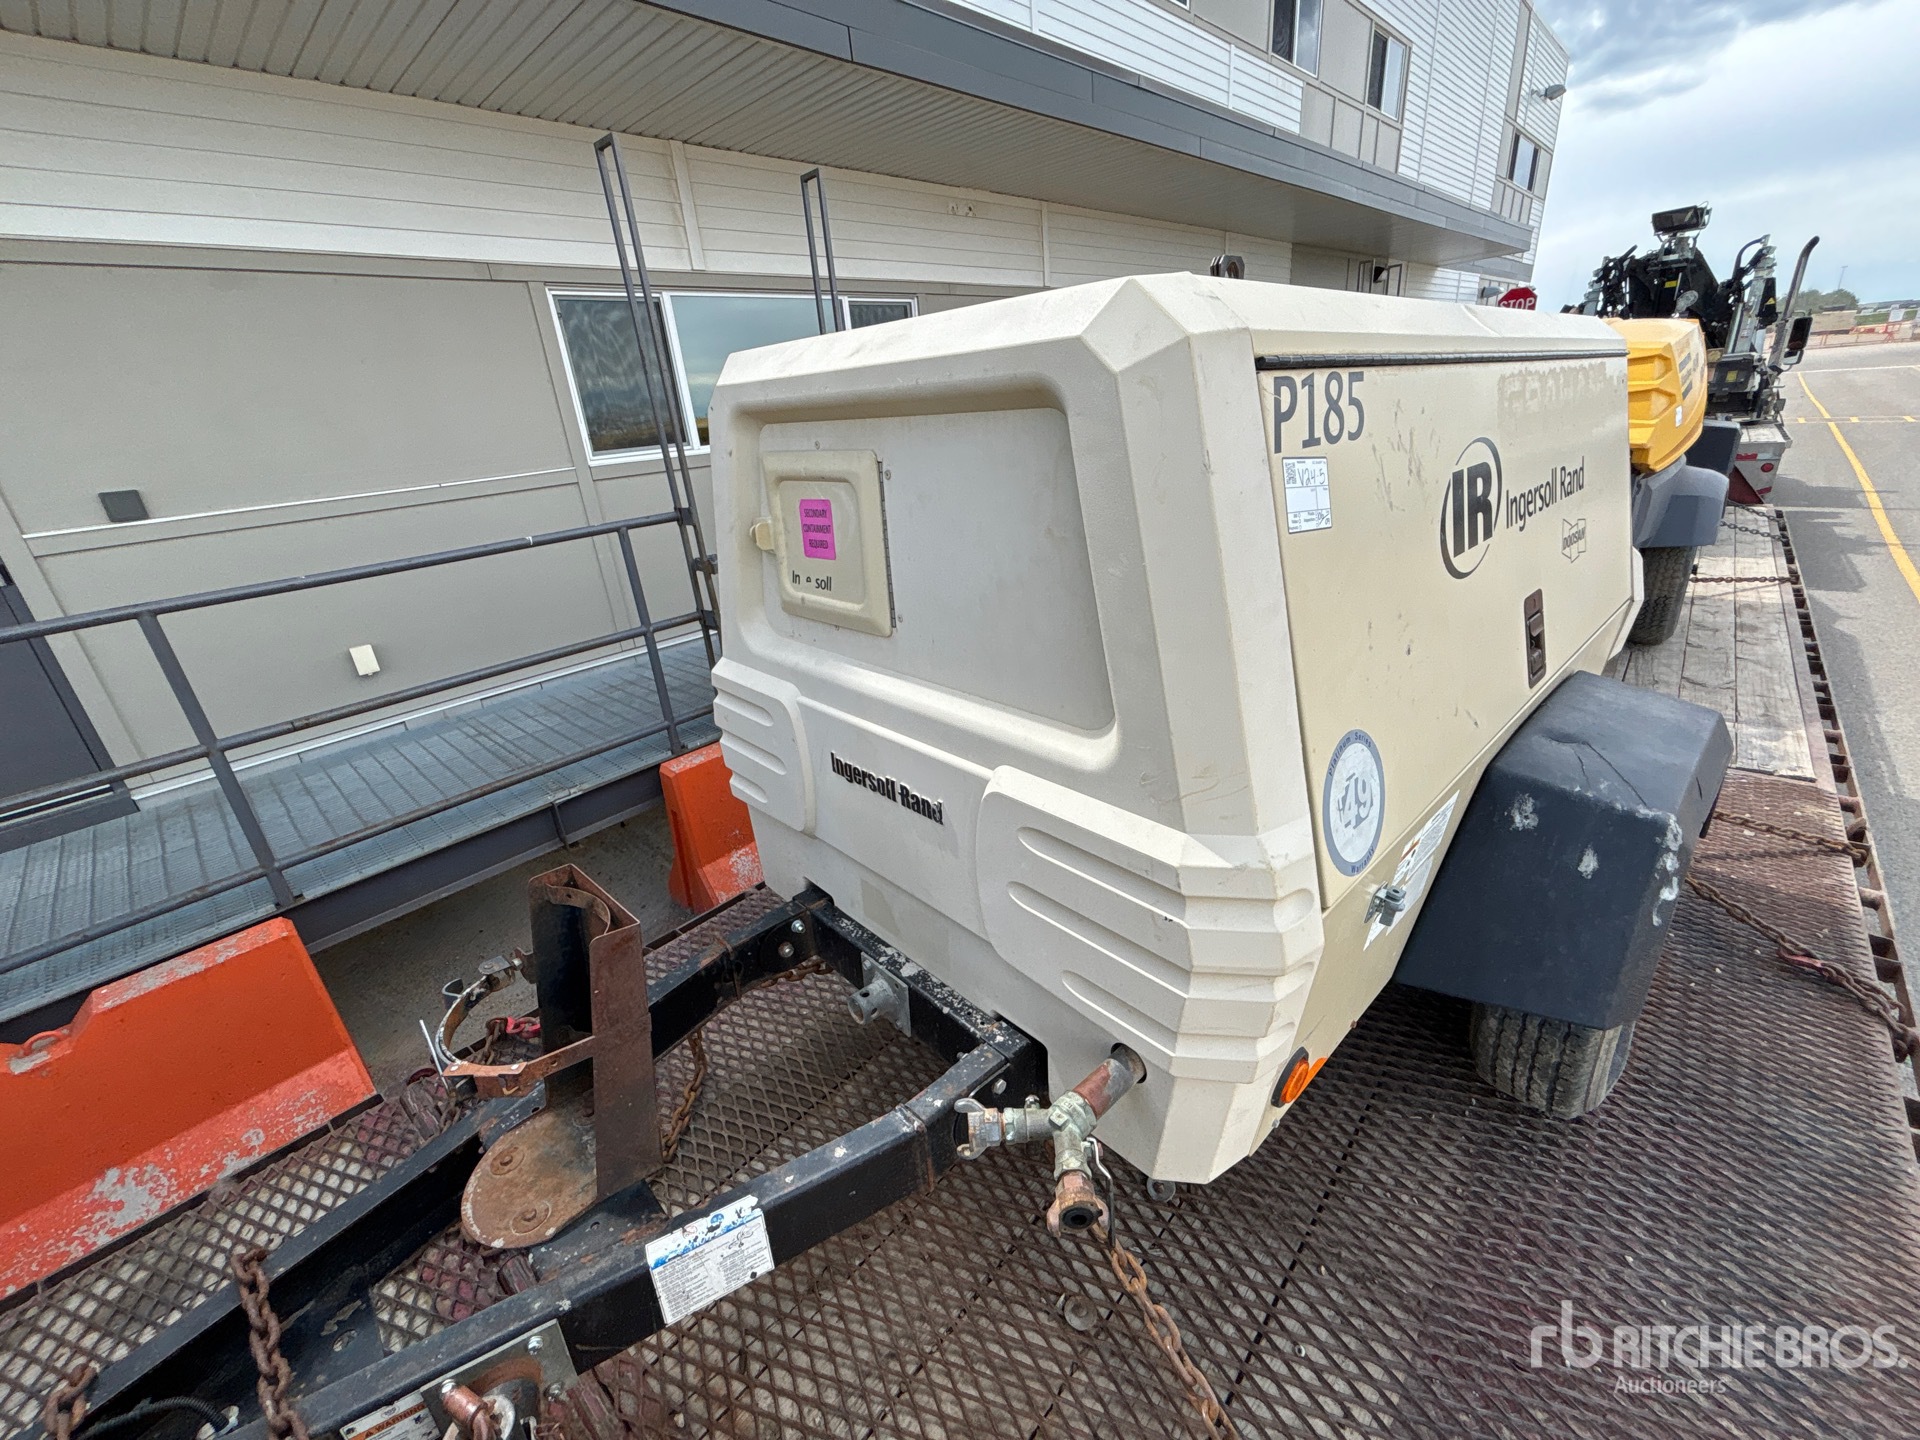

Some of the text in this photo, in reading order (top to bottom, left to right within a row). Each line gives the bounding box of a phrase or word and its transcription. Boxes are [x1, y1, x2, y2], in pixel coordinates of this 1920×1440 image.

[1272, 370, 1365, 455] P185
[1506, 455, 1585, 532] Ingersoll Rand
[804, 508, 828, 518] SECONDARY
[1452, 461, 1493, 558] IR
[802, 523, 831, 534] CONTAINMENT
[1562, 526, 1586, 550] DOOSAN
[808, 538, 829, 549] REQUIRED
[1329, 731, 1372, 777] Platinum Series
[1350, 846, 1375, 874] Warranty
